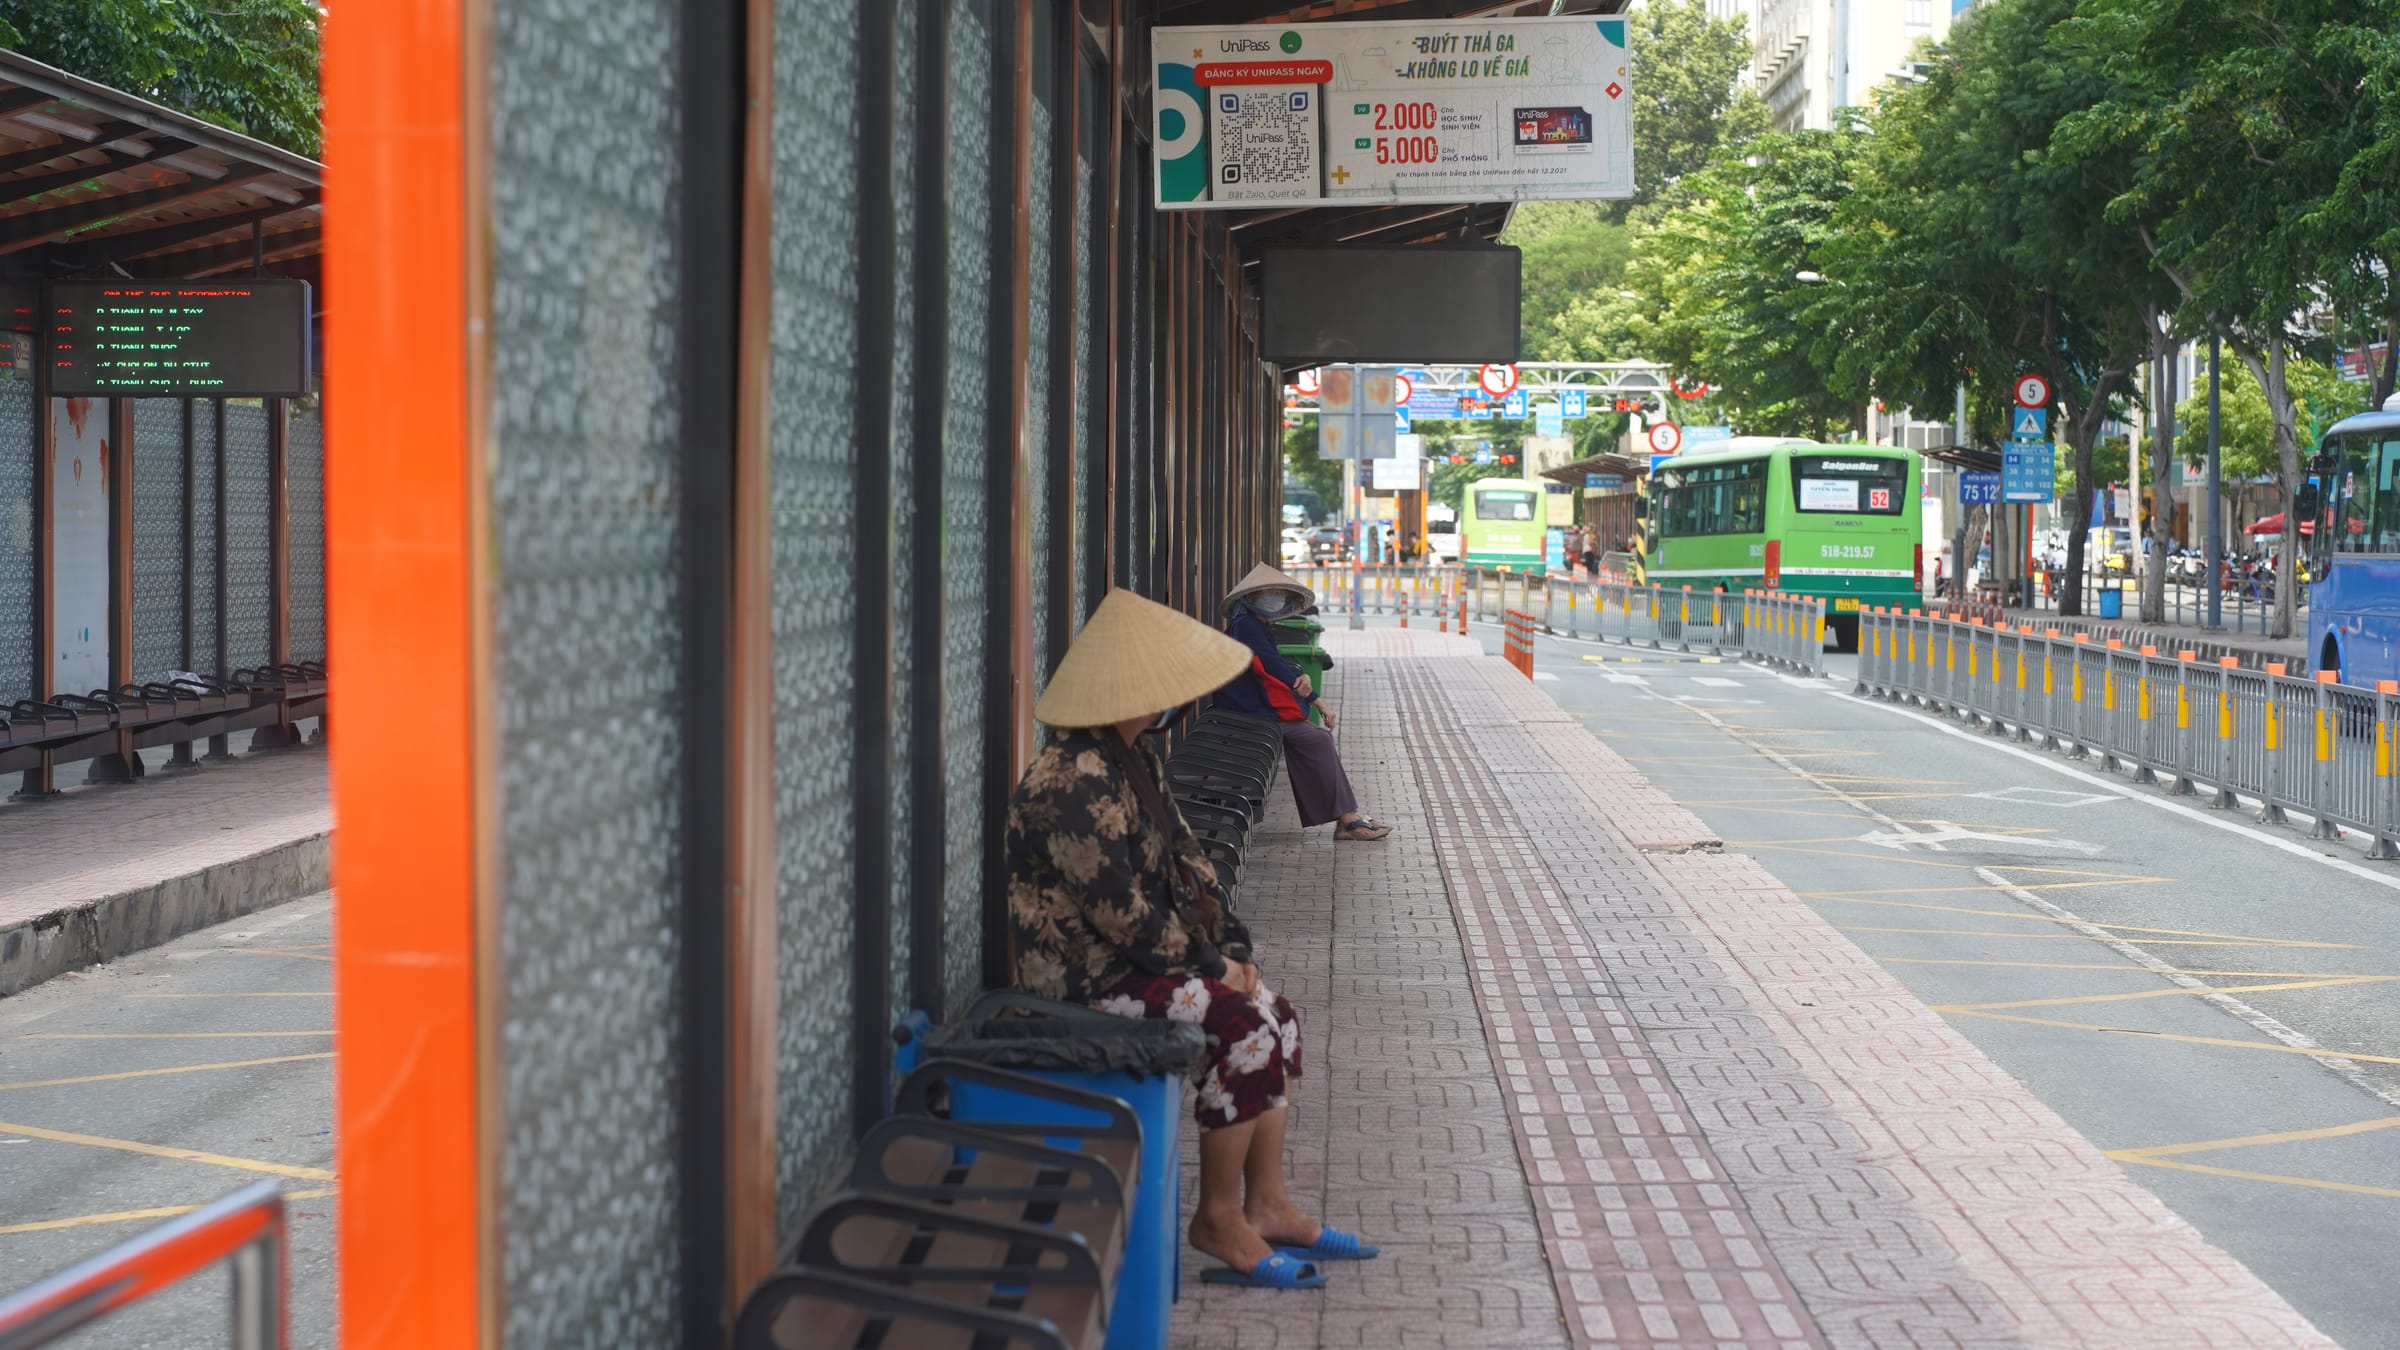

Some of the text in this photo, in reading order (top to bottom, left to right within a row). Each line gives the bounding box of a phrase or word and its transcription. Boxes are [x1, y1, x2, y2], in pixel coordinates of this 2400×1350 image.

[1220, 39, 1270, 53] UniPass
[1417, 30, 1514, 54] BUÝT THẢ GA
[1204, 66, 1325, 79] ĐĂNG KÝ UNIPASS NGAY
[1405, 54, 1531, 79] KHÔNG LO VỀ GIÁ
[1441, 114, 1483, 123] HỌC SINH/
[1517, 109, 1549, 119] UniPass
[1462, 122, 1481, 130] VIÊN
[1246, 132, 1285, 144] UniPass
[1442, 153, 1488, 162] PHỔ THÔNG
[1482, 168, 1510, 176] UniPass
[1541, 167, 1567, 175] 12.2021
[1245, 190, 1266, 199] Zalo,
[1267, 190, 1291, 199] Quét
[1292, 189, 1307, 198] QR
[2028, 384, 2037, 399] 5
[1661, 430, 1669, 445] 5
[1821, 461, 1880, 472] SaigonBus
[1963, 484, 1979, 500] 75
[1871, 491, 1888, 507] 52
[1821, 544, 1875, 559] 51B-219.57
